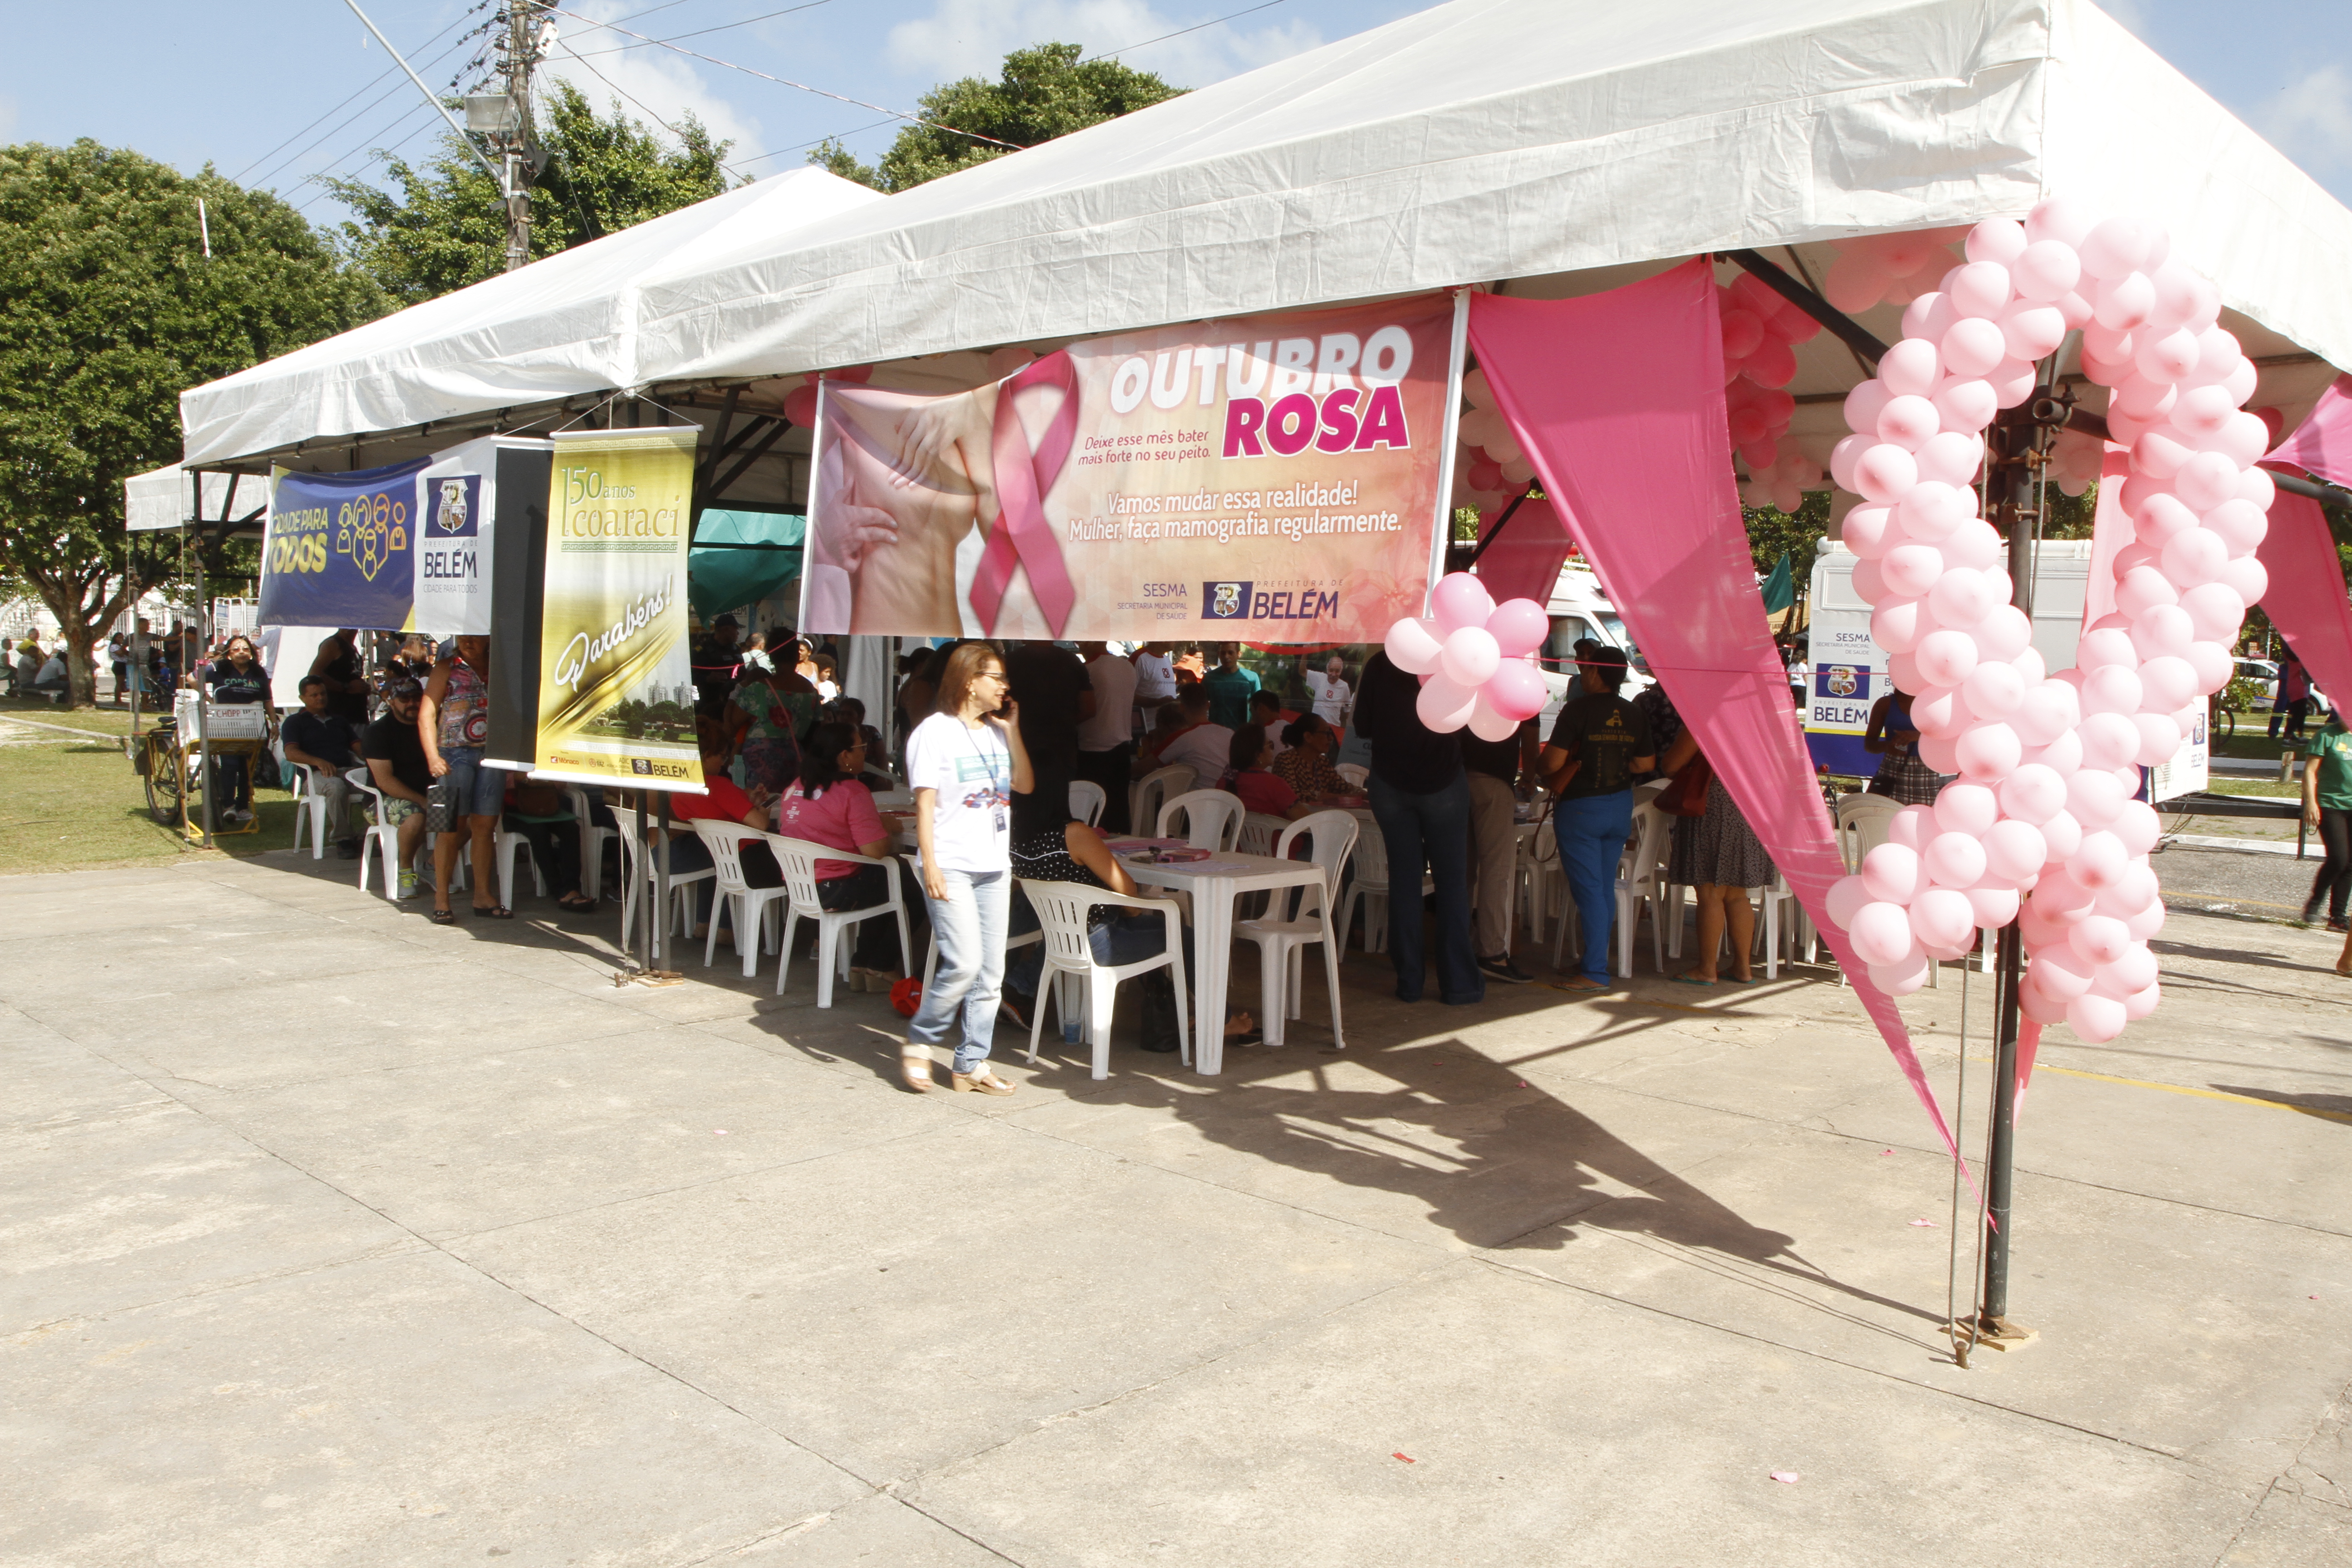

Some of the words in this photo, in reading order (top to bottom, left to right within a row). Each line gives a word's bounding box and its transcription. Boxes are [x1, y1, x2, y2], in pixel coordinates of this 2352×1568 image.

[1111, 325, 1413, 414] OUTUBRO
[1220, 383, 1411, 460] ROSA
[1085, 436, 1114, 450] Deixe
[1117, 435, 1143, 446] esse
[1146, 430, 1173, 444] mês
[1177, 429, 1209, 443] bater
[1078, 451, 1103, 466] mais
[1106, 450, 1132, 463] forte
[1135, 451, 1151, 461] no
[1154, 451, 1176, 461] seu
[1178, 445, 1211, 463] peito.
[561, 466, 604, 539] 150
[603, 485, 636, 500] anos
[1108, 492, 1161, 514] Vamos
[1165, 487, 1220, 512] mudar
[1223, 490, 1261, 510] essa
[1266, 479, 1358, 508] realidade!
[300, 507, 328, 531] PARA
[572, 495, 681, 539] coaraci
[1069, 517, 1123, 542] Mulher,
[1127, 515, 1161, 544] faça
[1164, 511, 1269, 544] mamografia
[1274, 508, 1402, 542] regularmente.
[265, 532, 328, 574] TODOS
[424, 539, 466, 548] PREFEITURA
[424, 548, 478, 578] BELÉM
[423, 583, 442, 593] CIDADE
[443, 583, 457, 593] PARA
[457, 583, 478, 593] TODOS
[1143, 583, 1188, 597] SESMA
[1166, 611, 1187, 620] SAÚDE
[1252, 588, 1339, 619] BELÉM
[554, 572, 673, 693] Parabéns!
[1836, 633, 1870, 642] SESMA
[216, 709, 242, 718] CHOPP
[1814, 706, 1869, 725] BELÉM
[653, 764, 690, 779] BELÉM
